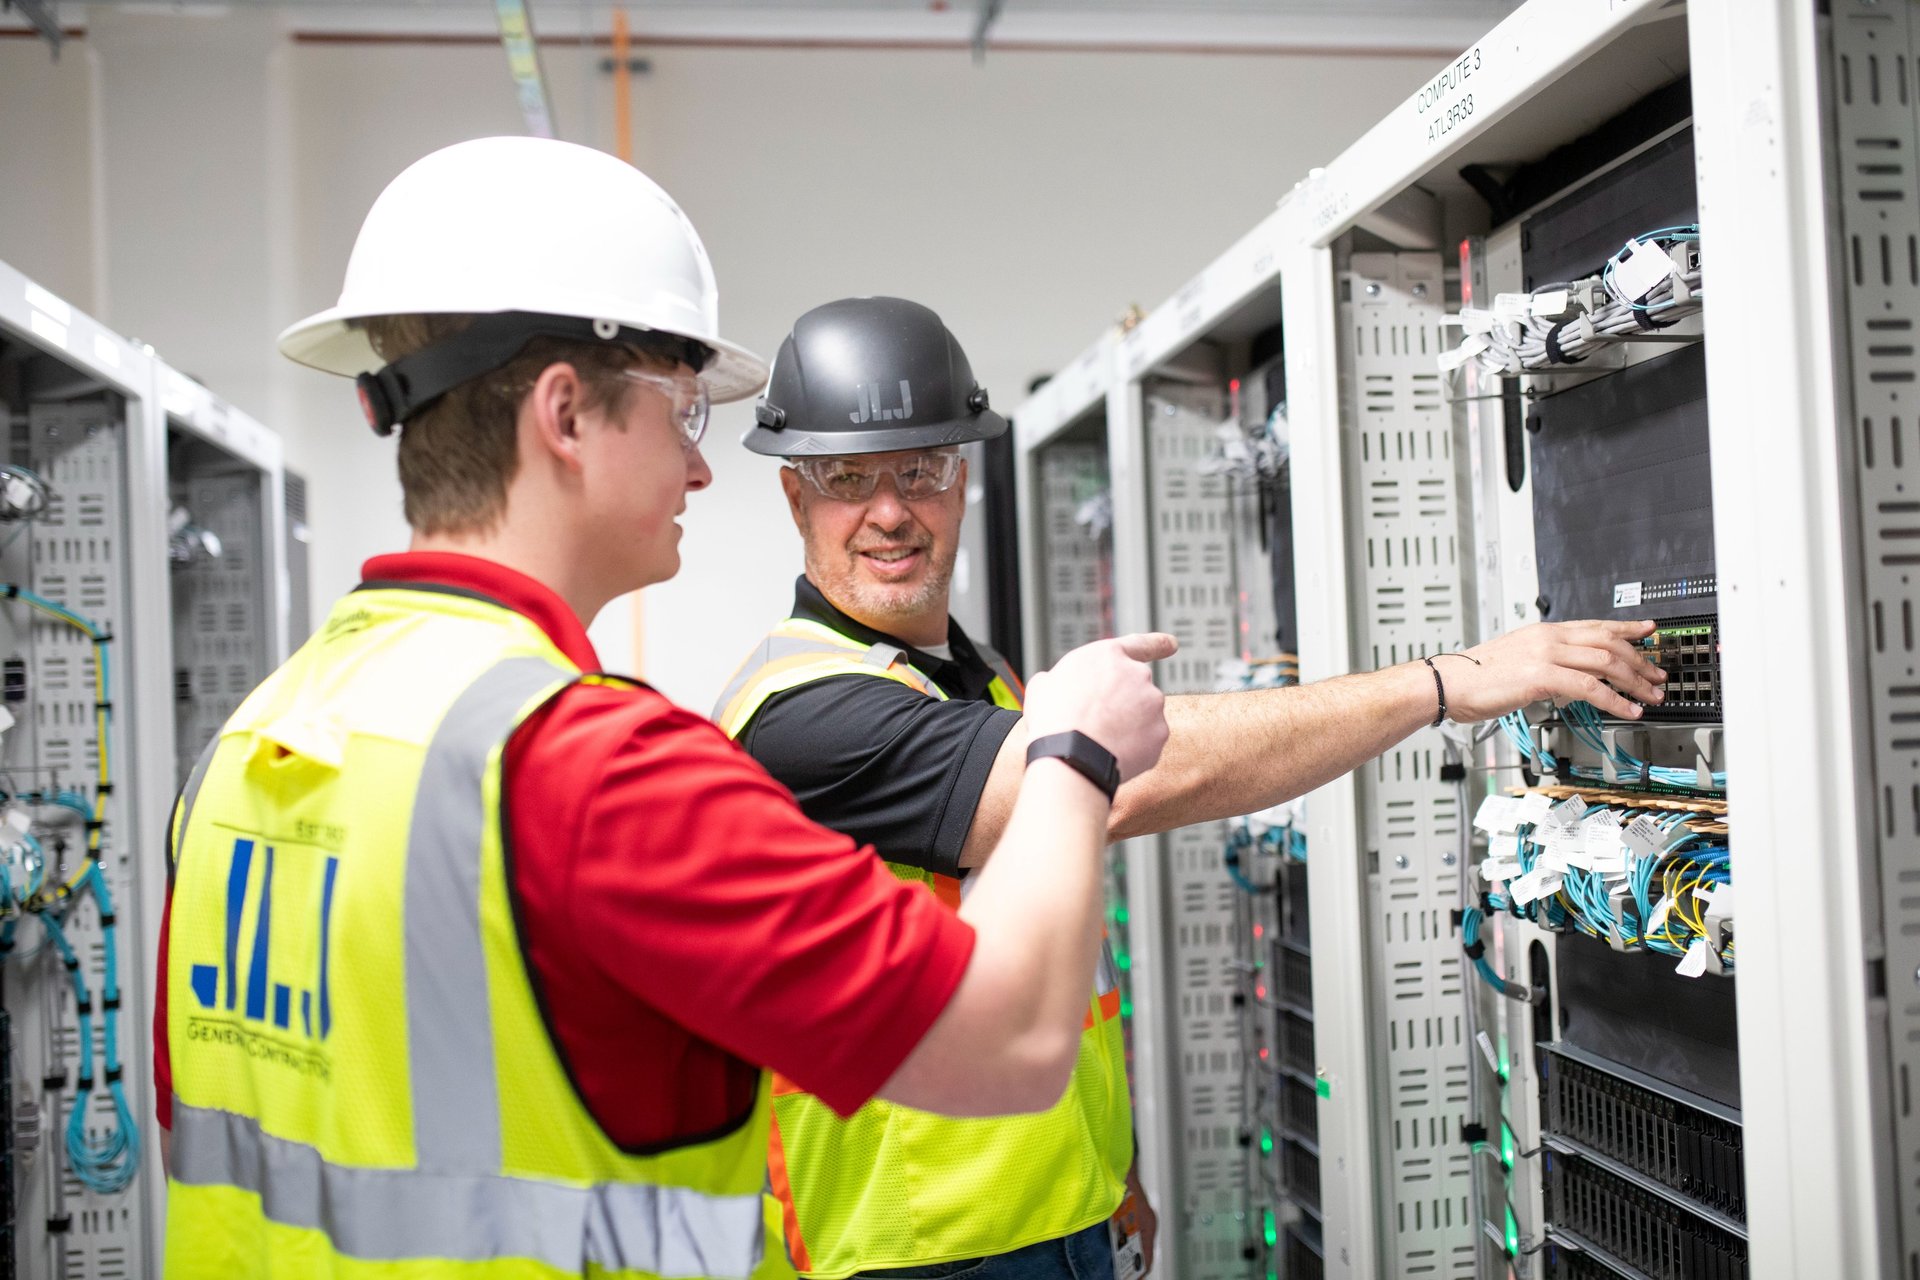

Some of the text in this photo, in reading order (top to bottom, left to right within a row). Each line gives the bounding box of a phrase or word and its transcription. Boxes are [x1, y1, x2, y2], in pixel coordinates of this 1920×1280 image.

[1417, 48, 1482, 113] COMPUTE 3
[1428, 94, 1474, 144] ATL3R33
[849, 379, 914, 424] JLJ
